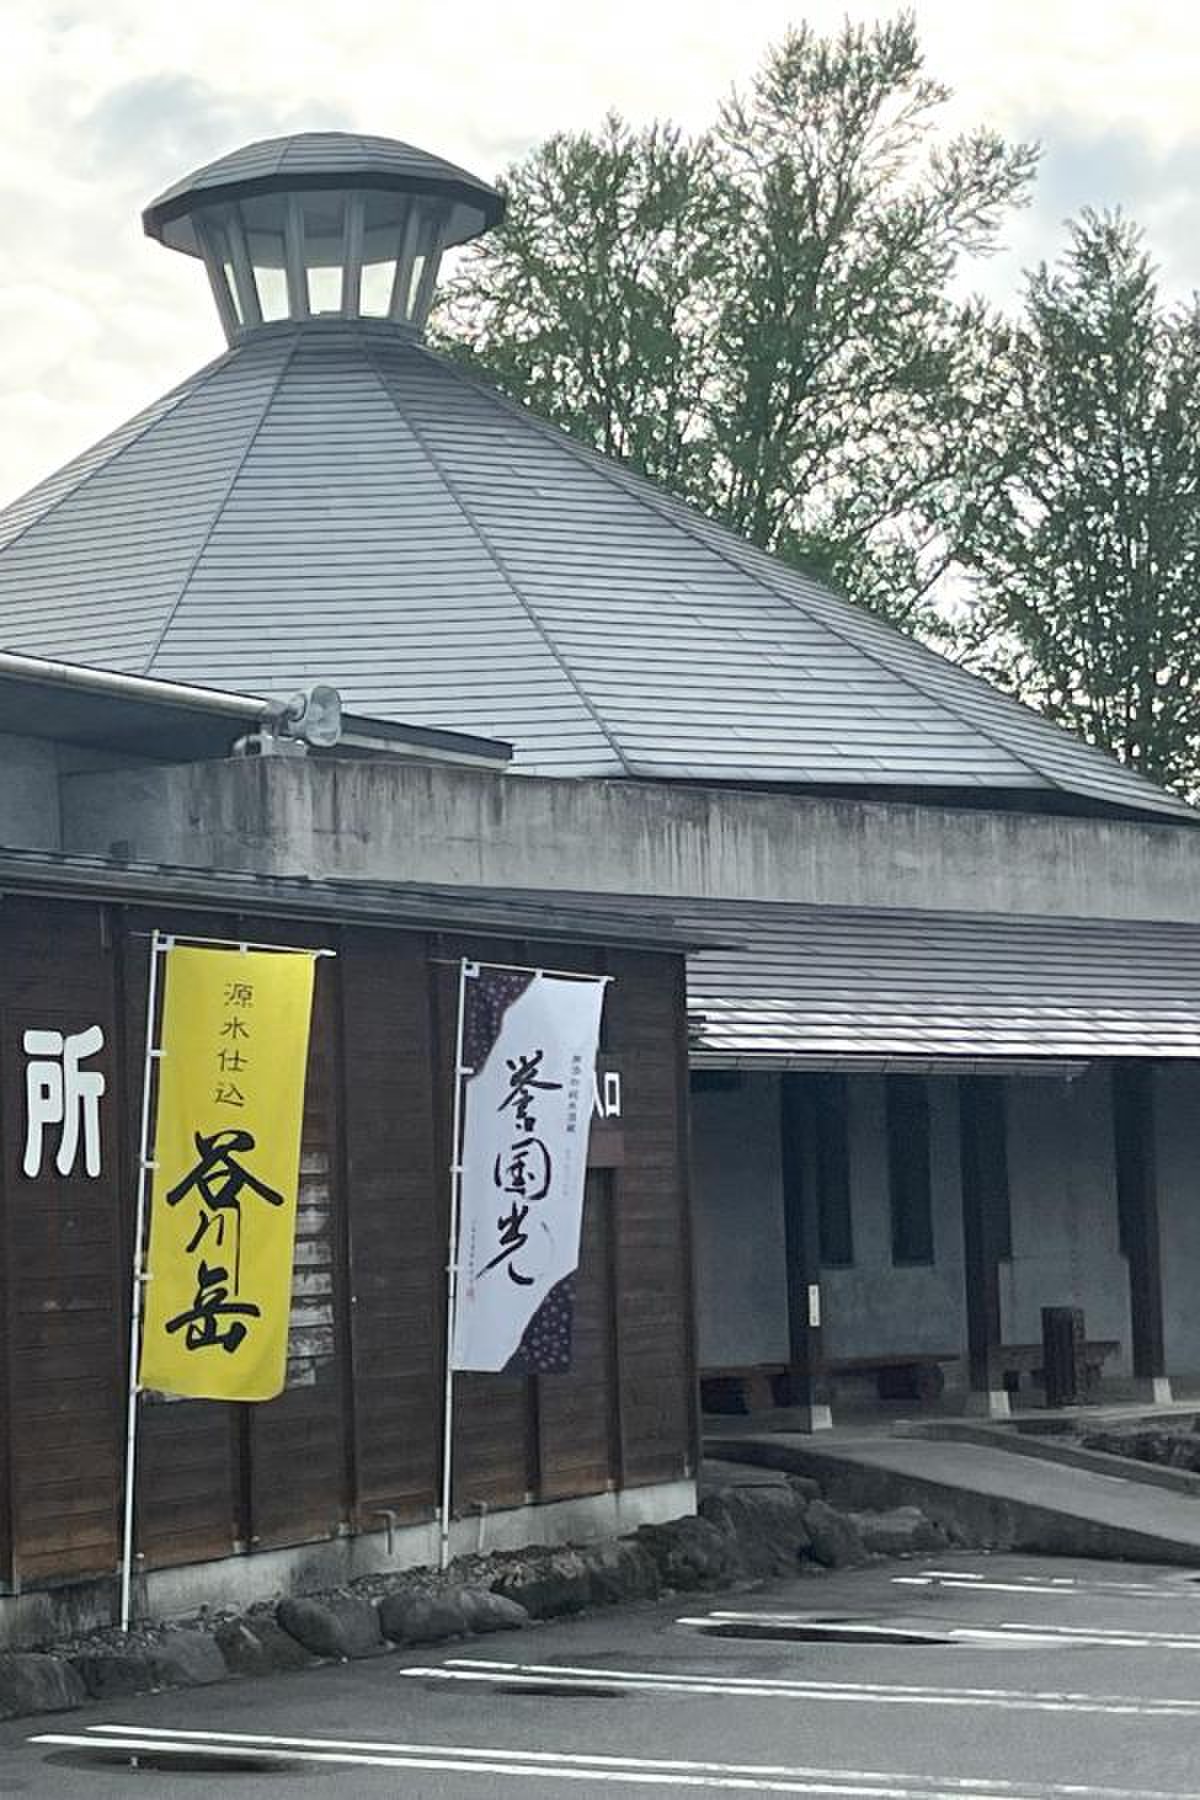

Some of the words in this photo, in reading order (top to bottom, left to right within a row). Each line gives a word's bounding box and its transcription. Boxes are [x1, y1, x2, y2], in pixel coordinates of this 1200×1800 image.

[213, 981, 255, 1108] 源水仕込
[165, 1129, 285, 1355] 谷川岳
